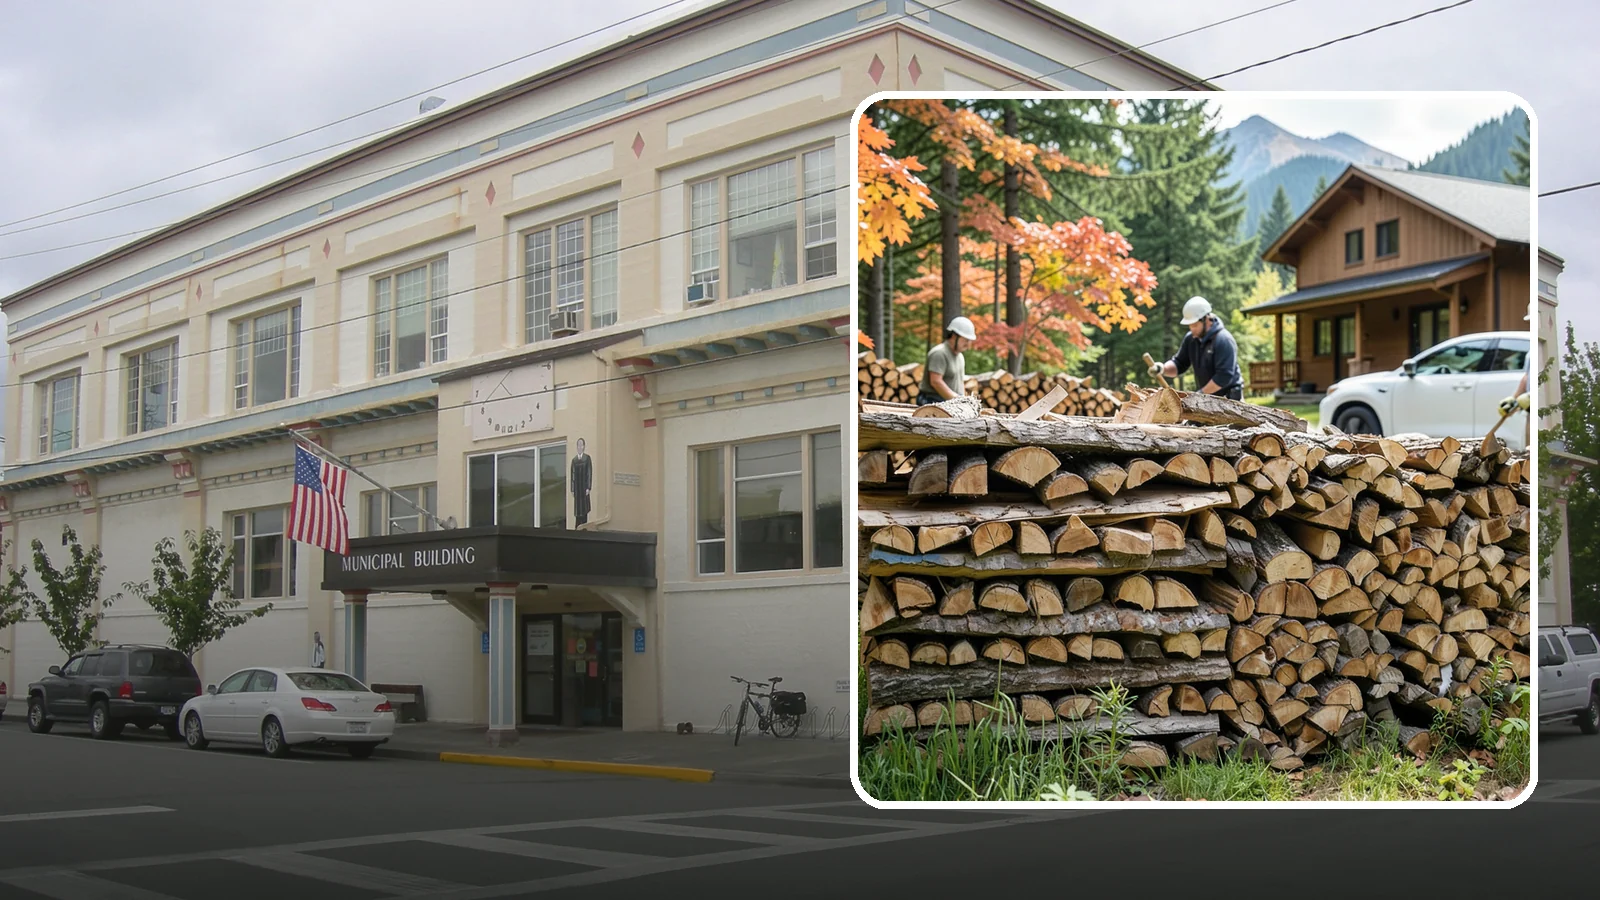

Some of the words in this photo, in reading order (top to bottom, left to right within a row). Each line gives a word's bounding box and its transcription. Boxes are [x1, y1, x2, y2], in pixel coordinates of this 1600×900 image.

[475, 390, 479, 398] 7
[536, 402, 540, 410] 4
[480, 407, 485, 415] 8
[487, 417, 492, 425] 9
[529, 414, 533, 422] 3
[494, 424, 500, 432] 10
[521, 420, 525, 428] 2
[501, 425, 506, 434] 11
[507, 425, 513, 433] 12
[342, 552, 405, 572] MUNICIPAL
[414, 546, 475, 567] BUILDING
